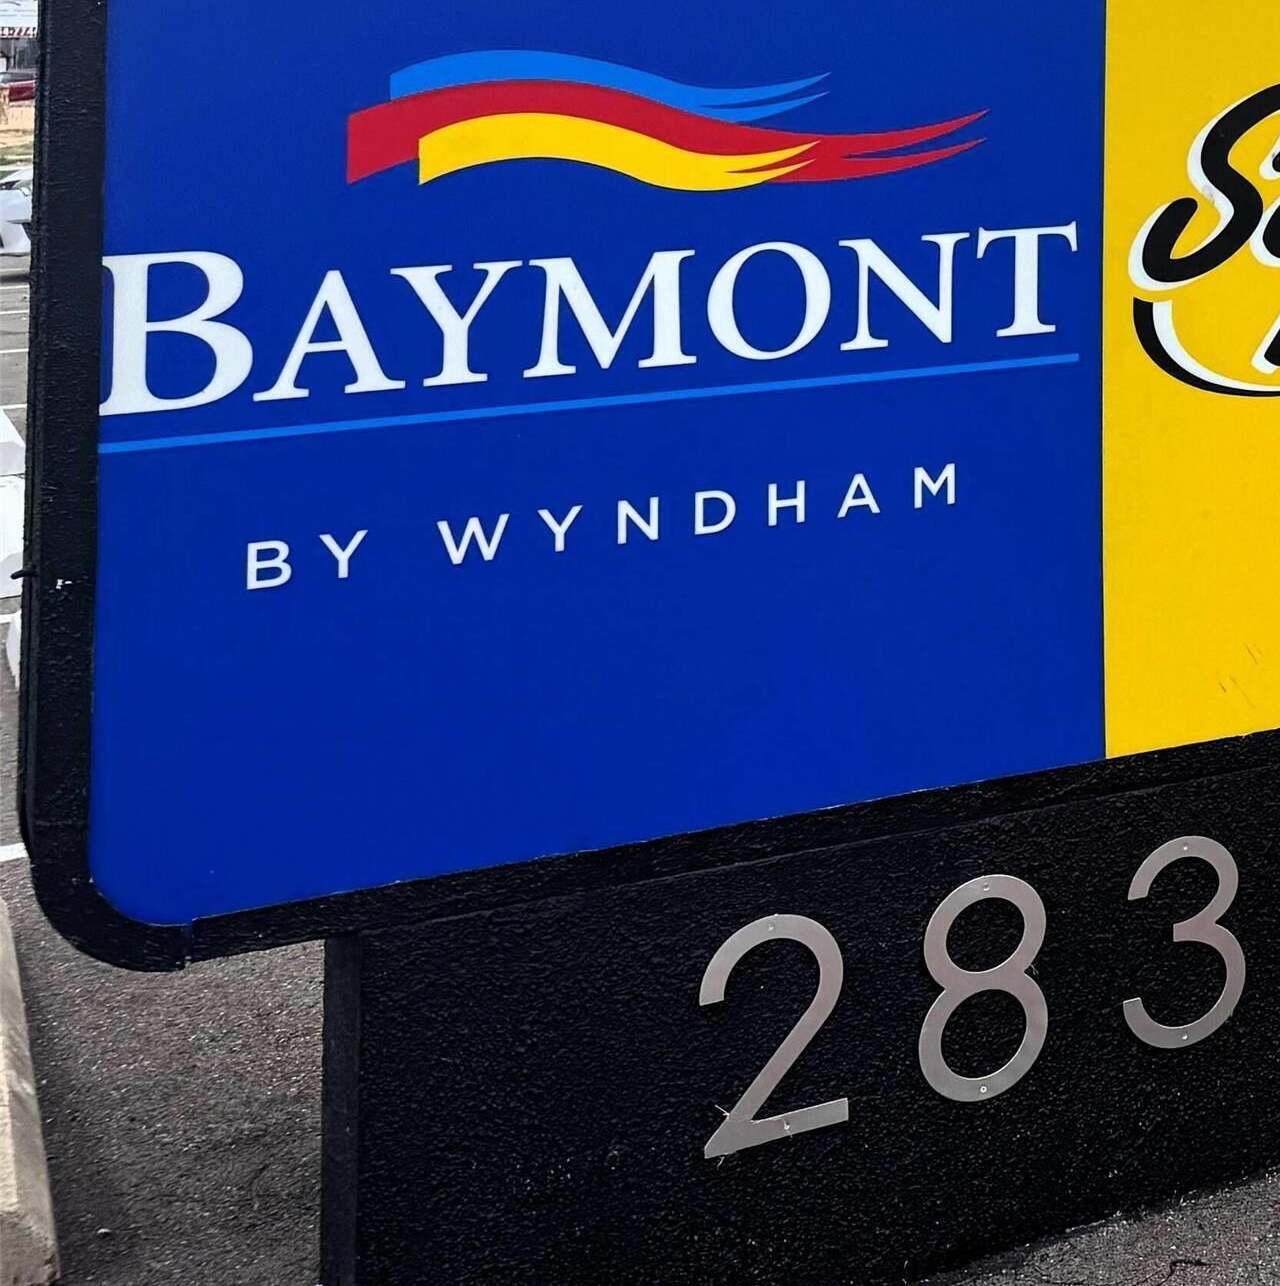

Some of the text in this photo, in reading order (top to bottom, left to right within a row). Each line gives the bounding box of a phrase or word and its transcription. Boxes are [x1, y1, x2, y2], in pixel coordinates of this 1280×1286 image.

[99, 221, 1078, 416] BAYMONT
[246, 463, 958, 591] BY WYNDHAM
